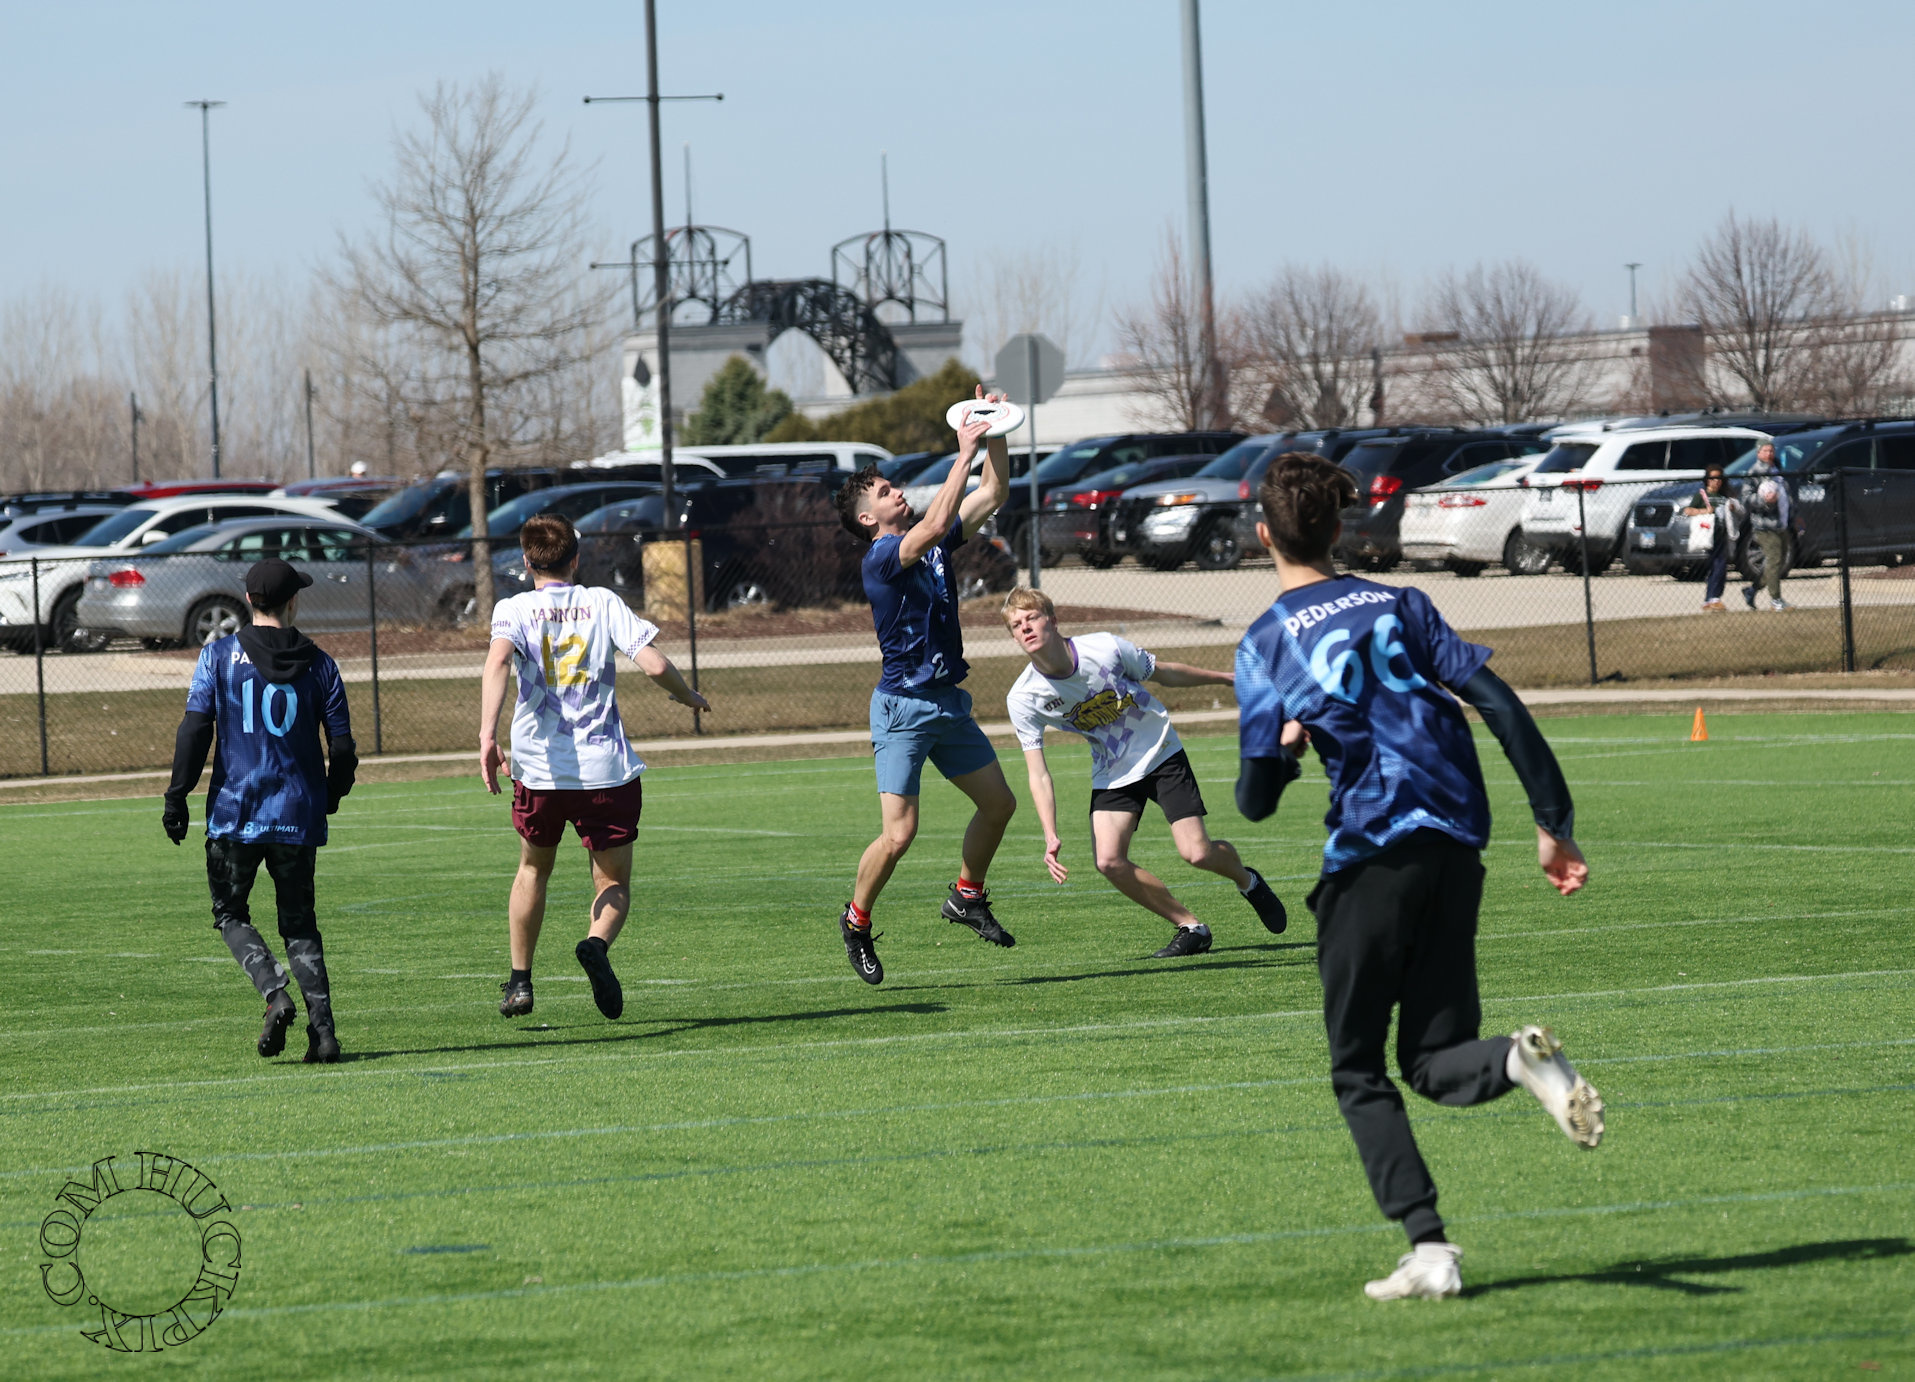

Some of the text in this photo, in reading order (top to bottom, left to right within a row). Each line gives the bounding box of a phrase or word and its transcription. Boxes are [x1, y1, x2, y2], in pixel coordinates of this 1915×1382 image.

[1285, 591, 1395, 637] PEDERSON
[1310, 614, 1428, 704] 66
[242, 678, 298, 737] 10
